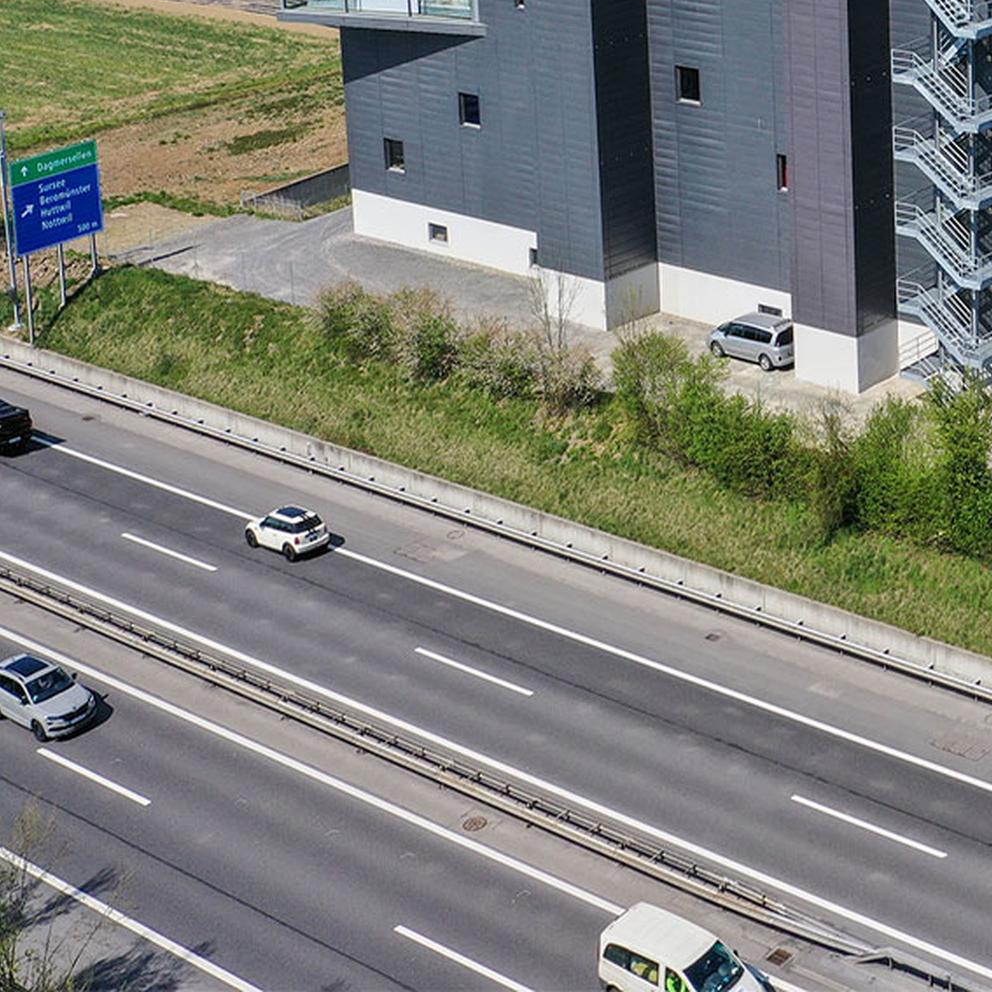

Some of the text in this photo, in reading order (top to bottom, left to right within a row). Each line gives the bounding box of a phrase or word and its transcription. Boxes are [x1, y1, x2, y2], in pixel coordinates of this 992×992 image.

[37, 151, 91, 172] Dagmersellen
[38, 179, 66, 194] Sursee
[40, 184, 91, 206] Beromünster
[42, 213, 73, 230] Nottwil
